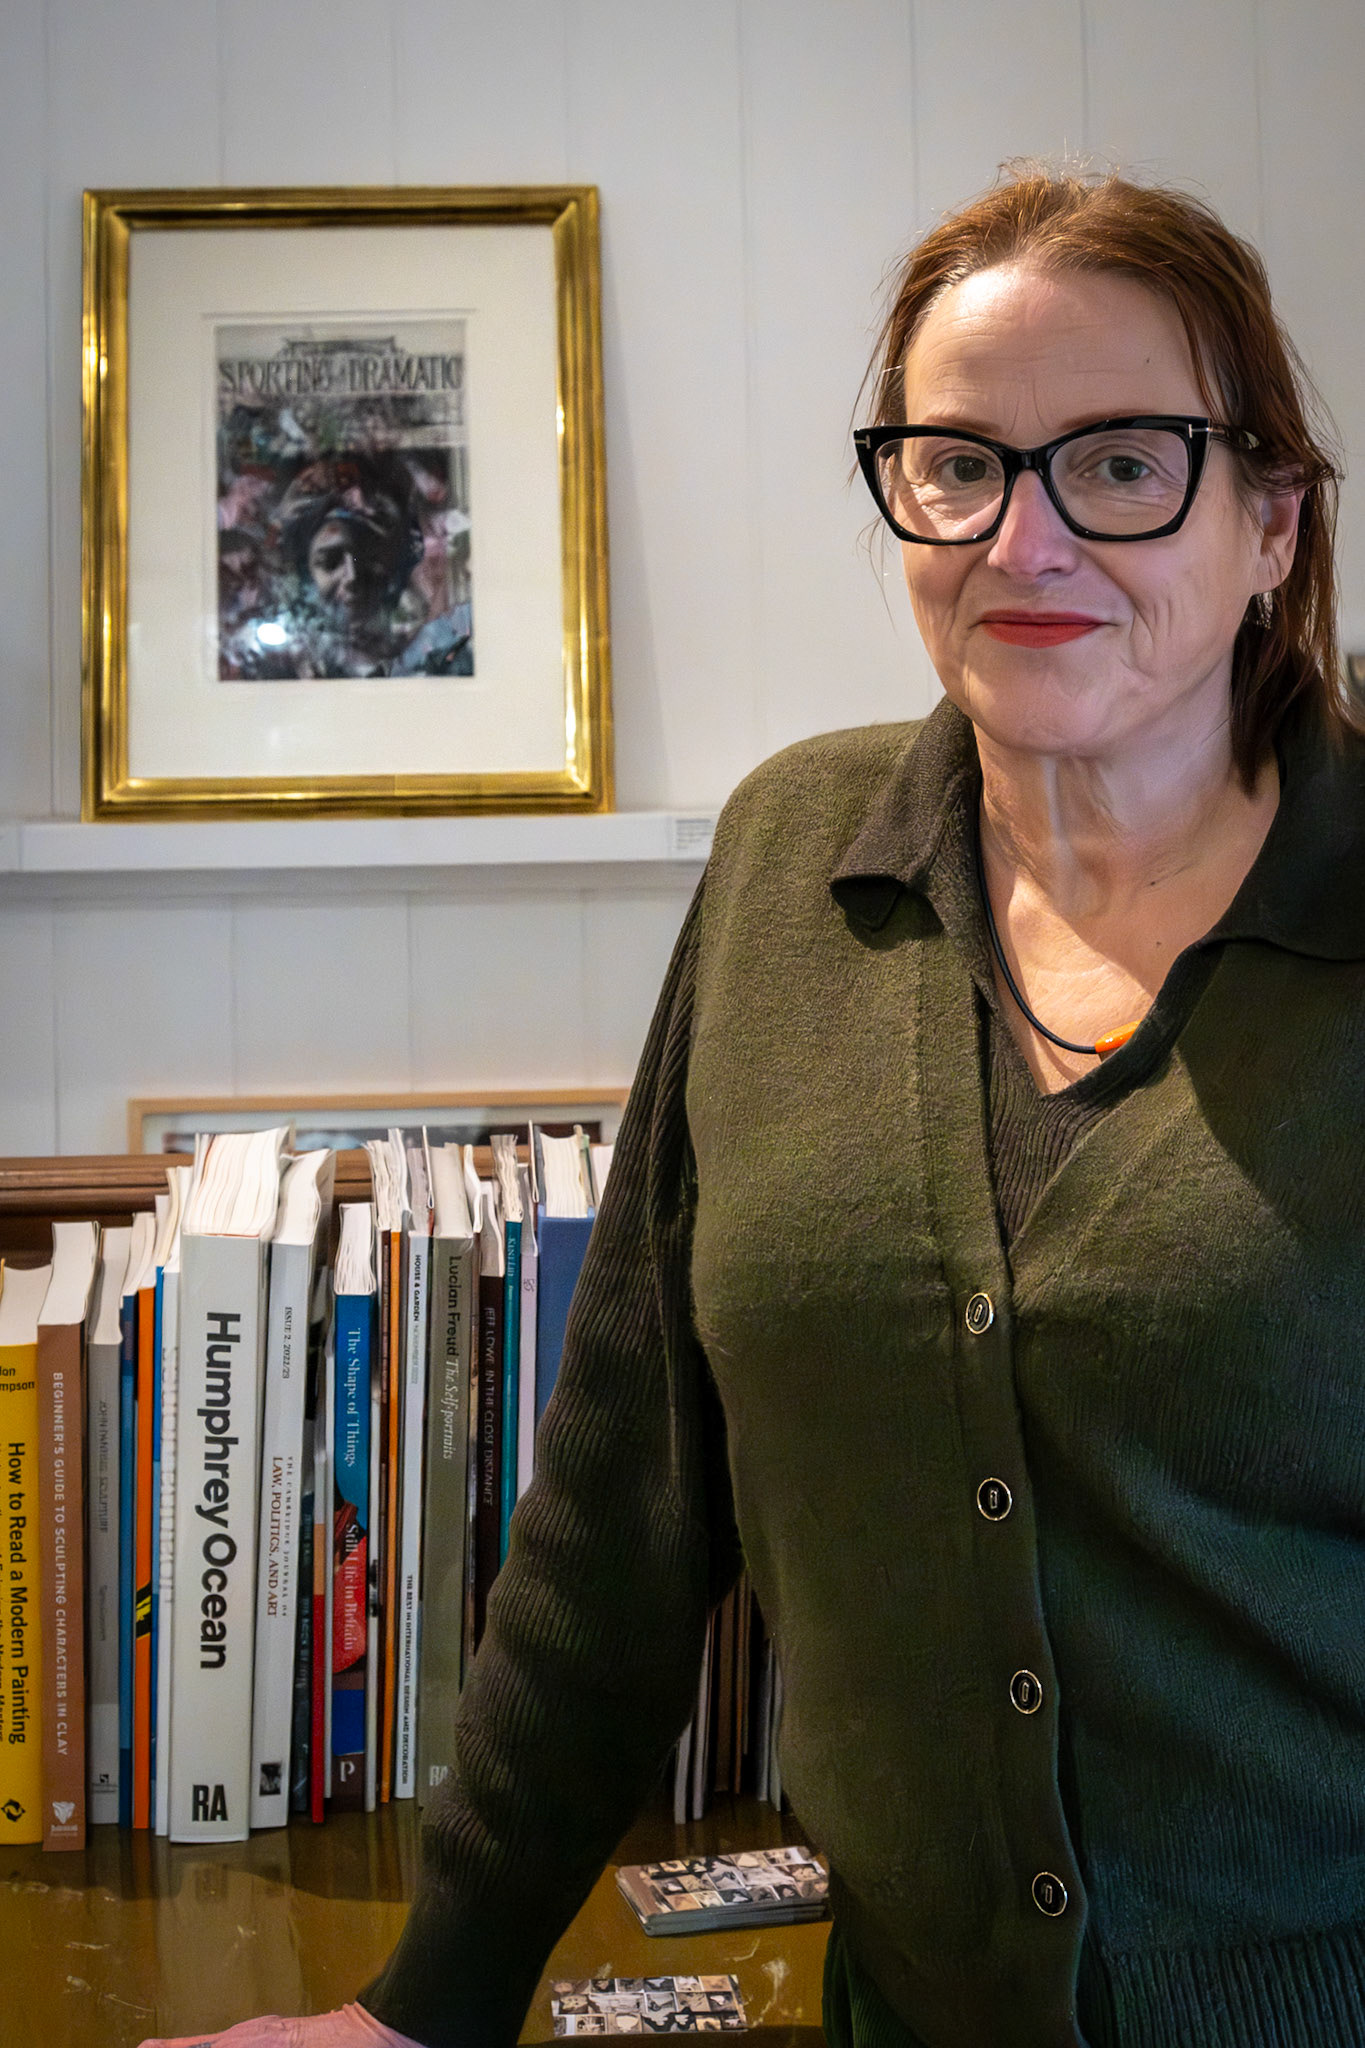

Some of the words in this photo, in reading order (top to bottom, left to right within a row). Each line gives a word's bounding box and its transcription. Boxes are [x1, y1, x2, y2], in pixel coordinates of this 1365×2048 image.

[414, 1254, 423, 1281] HOUSE
[447, 1256, 462, 1308] Lucian
[283, 1306, 293, 1333] ISSUE
[413, 1290, 422, 1322] GARDEN
[483, 1307, 496, 1326] JEFF
[347, 1327, 362, 1354] The
[445, 1312, 461, 1358] Freud
[281, 1344, 291, 1379] 2022/23
[344, 1357, 361, 1399] Shape
[444, 1359, 459, 1382] The
[485, 1370, 495, 1382] IN
[347, 1401, 361, 1415] of
[484, 1386, 495, 1406] THE
[53, 1372, 65, 1455] BEGINNER'S
[195, 1312, 241, 1528] Humphrey
[440, 1384, 459, 1460] Self-portraits
[344, 1419, 360, 1468] Things
[9, 1442, 26, 1485] How
[54, 1459, 66, 1501] GUIDE
[271, 1456, 284, 1488] LAW,
[10, 1493, 26, 1511] to
[55, 1506, 66, 1525] TO
[10, 1516, 27, 1563] Read
[268, 1492, 283, 1557] POLITICS,
[344, 1524, 359, 1553] Still
[10, 1570, 23, 1581] a
[55, 1527, 67, 1604] SCULPTING
[267, 1559, 280, 1589] AND
[344, 1556, 359, 1583] Life
[200, 1533, 238, 1669] Ocean
[266, 1591, 279, 1619] ART
[344, 1585, 359, 1600] in
[406, 1592, 414, 1610] BEST
[10, 1587, 28, 1659] Modern
[343, 1602, 358, 1651] Britain
[405, 1612, 413, 1621] IN
[56, 1609, 68, 1699] CHARACTERS
[404, 1622, 412, 1682] INTERNATIONAL
[8, 1666, 30, 1745] Painting
[57, 1703, 68, 1718] IN
[57, 1722, 69, 1756] CLAY
[402, 1734, 410, 1785] DECORATION
[192, 1784, 229, 1822] RA
